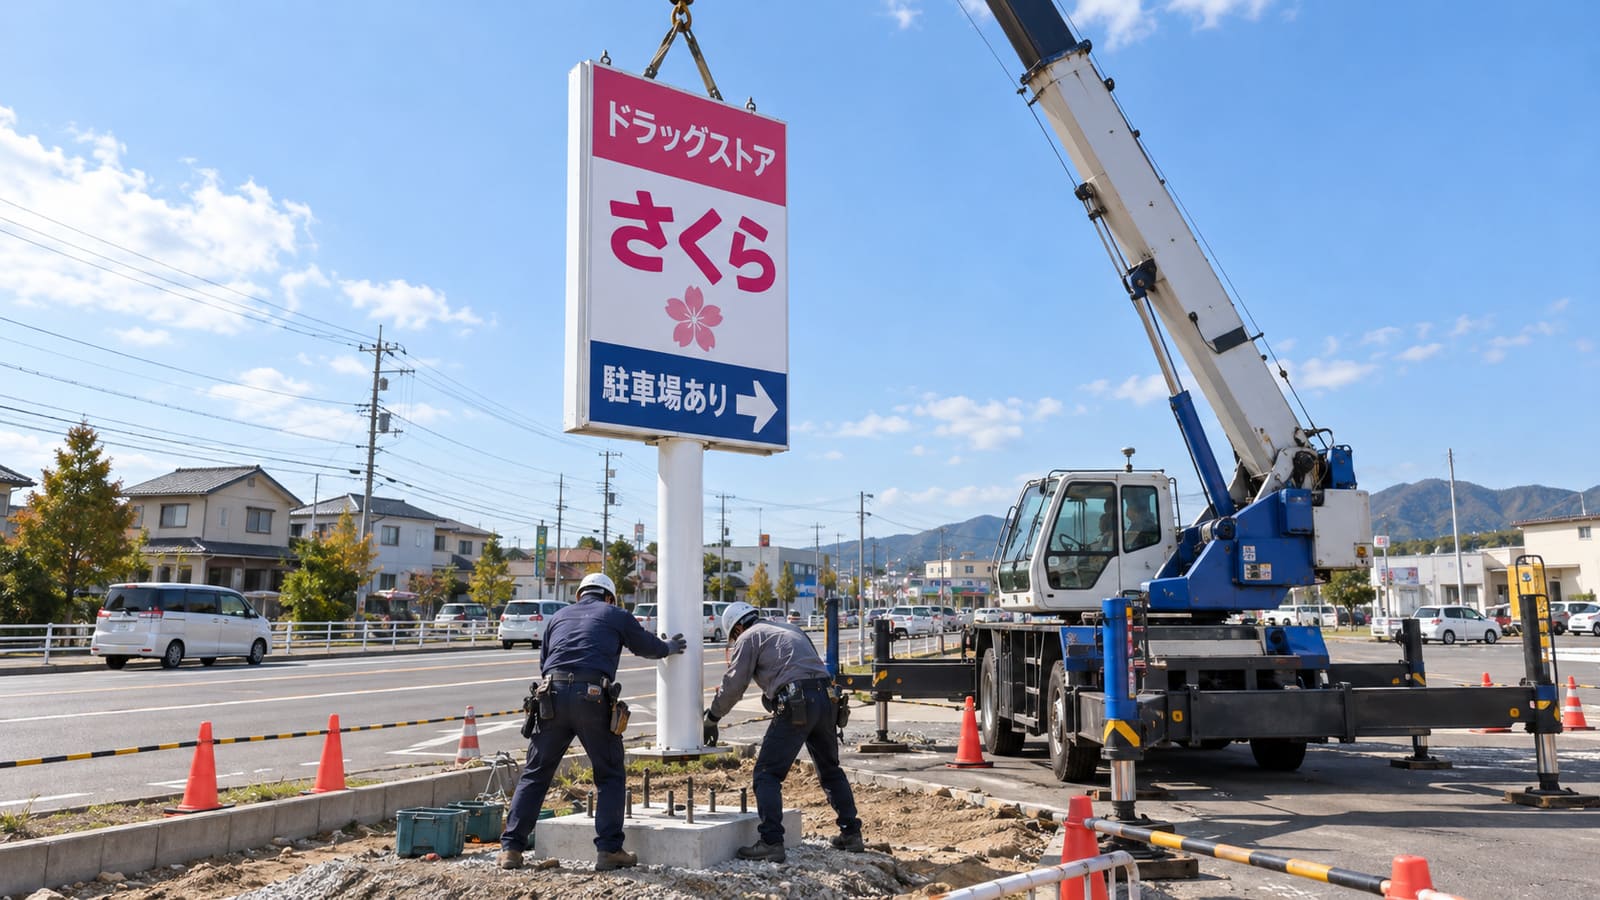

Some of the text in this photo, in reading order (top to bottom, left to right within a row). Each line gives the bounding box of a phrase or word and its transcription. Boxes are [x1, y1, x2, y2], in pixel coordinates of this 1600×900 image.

[609, 100, 776, 177] ドラッグストア
[609, 190, 776, 293] さくら
[602, 365, 727, 418] 駐車場あり
